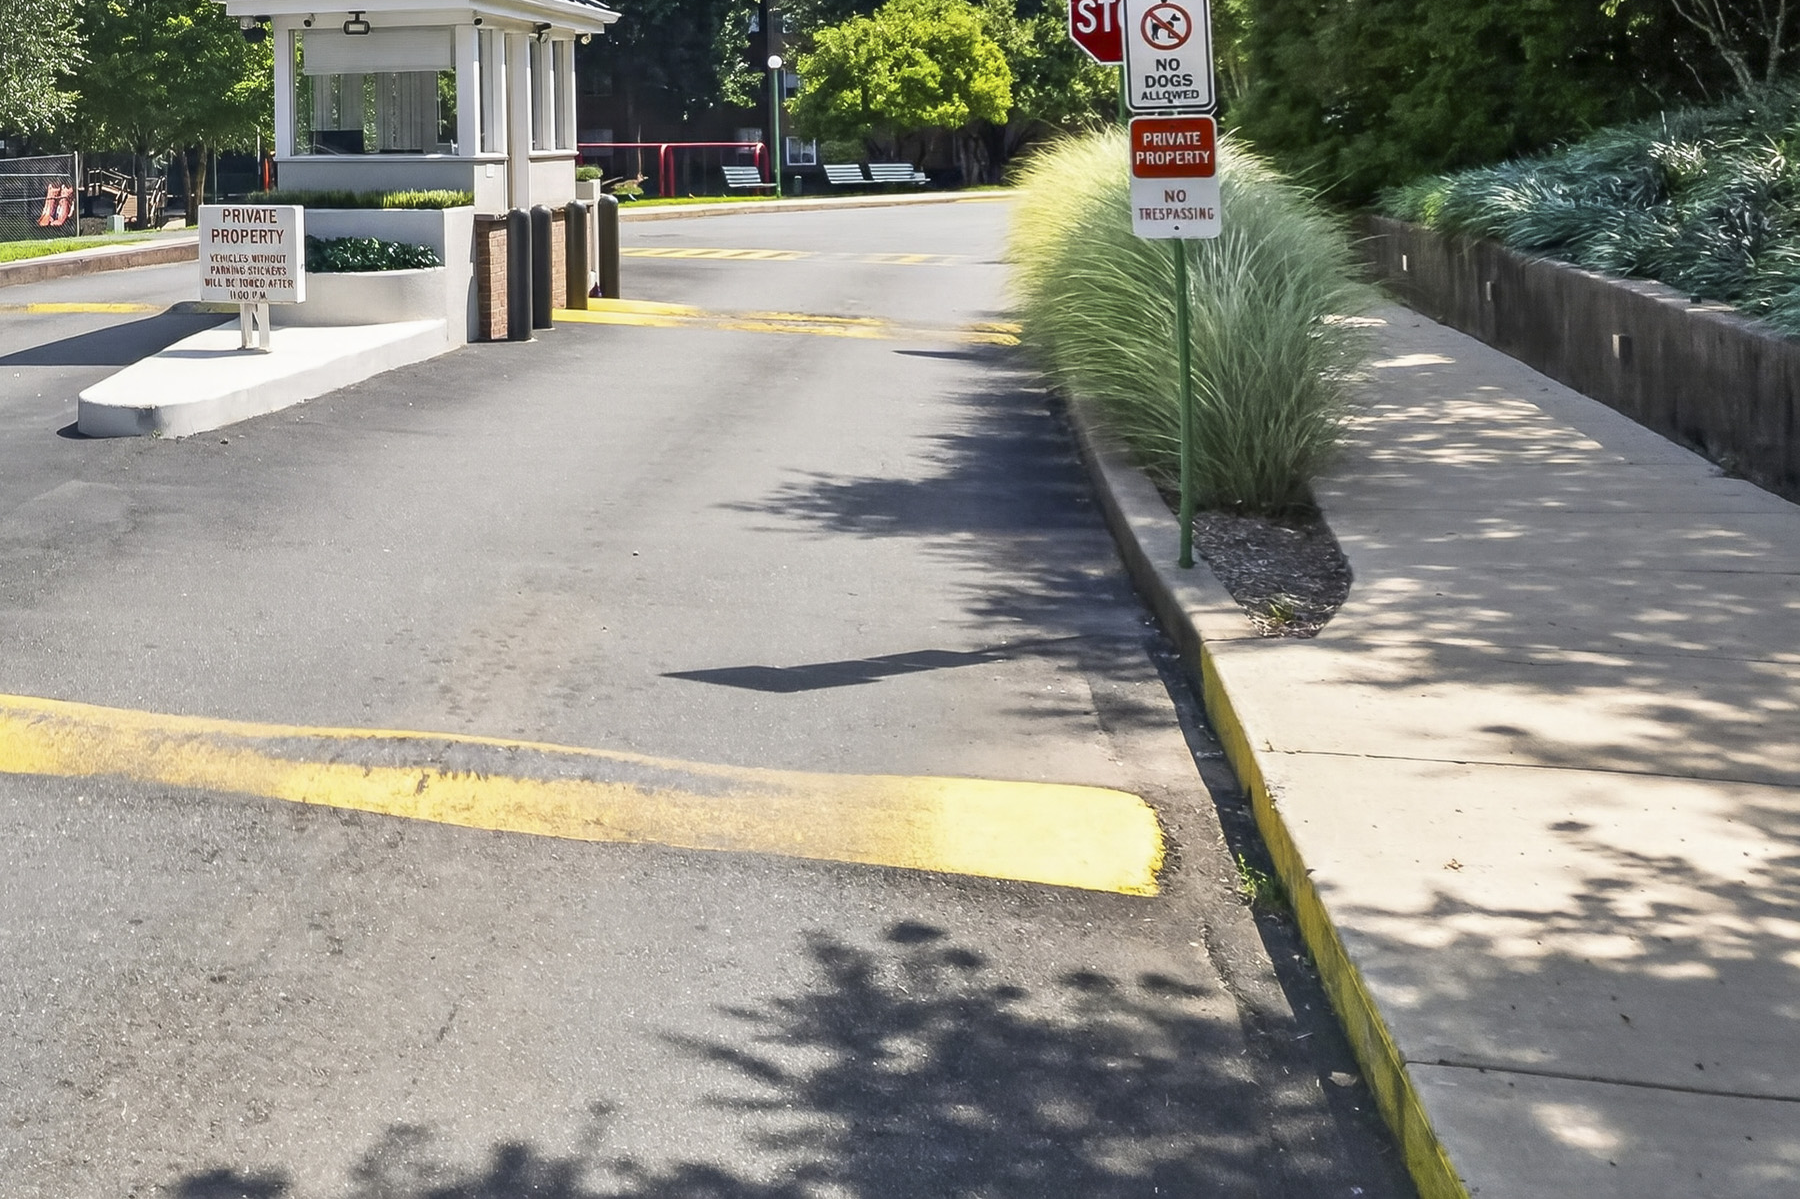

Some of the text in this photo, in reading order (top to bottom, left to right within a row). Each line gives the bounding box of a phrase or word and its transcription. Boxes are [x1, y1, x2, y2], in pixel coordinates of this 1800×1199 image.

[1156, 58, 1180, 71] NO
[1144, 74, 1194, 88] DOGS
[1141, 90, 1200, 100] ALLOWED
[1143, 131, 1202, 146] PRIVATE
[1136, 151, 1210, 165] PROPERTY
[1164, 189, 1187, 203] NO
[223, 209, 277, 223] PRIVATE
[1139, 207, 1215, 221] TRESPASSING
[212, 229, 284, 244] PROPERTY
[251, 254, 287, 263] WITHOUT
[205, 278, 222, 288] WILL
[268, 278, 294, 289] AFTER
